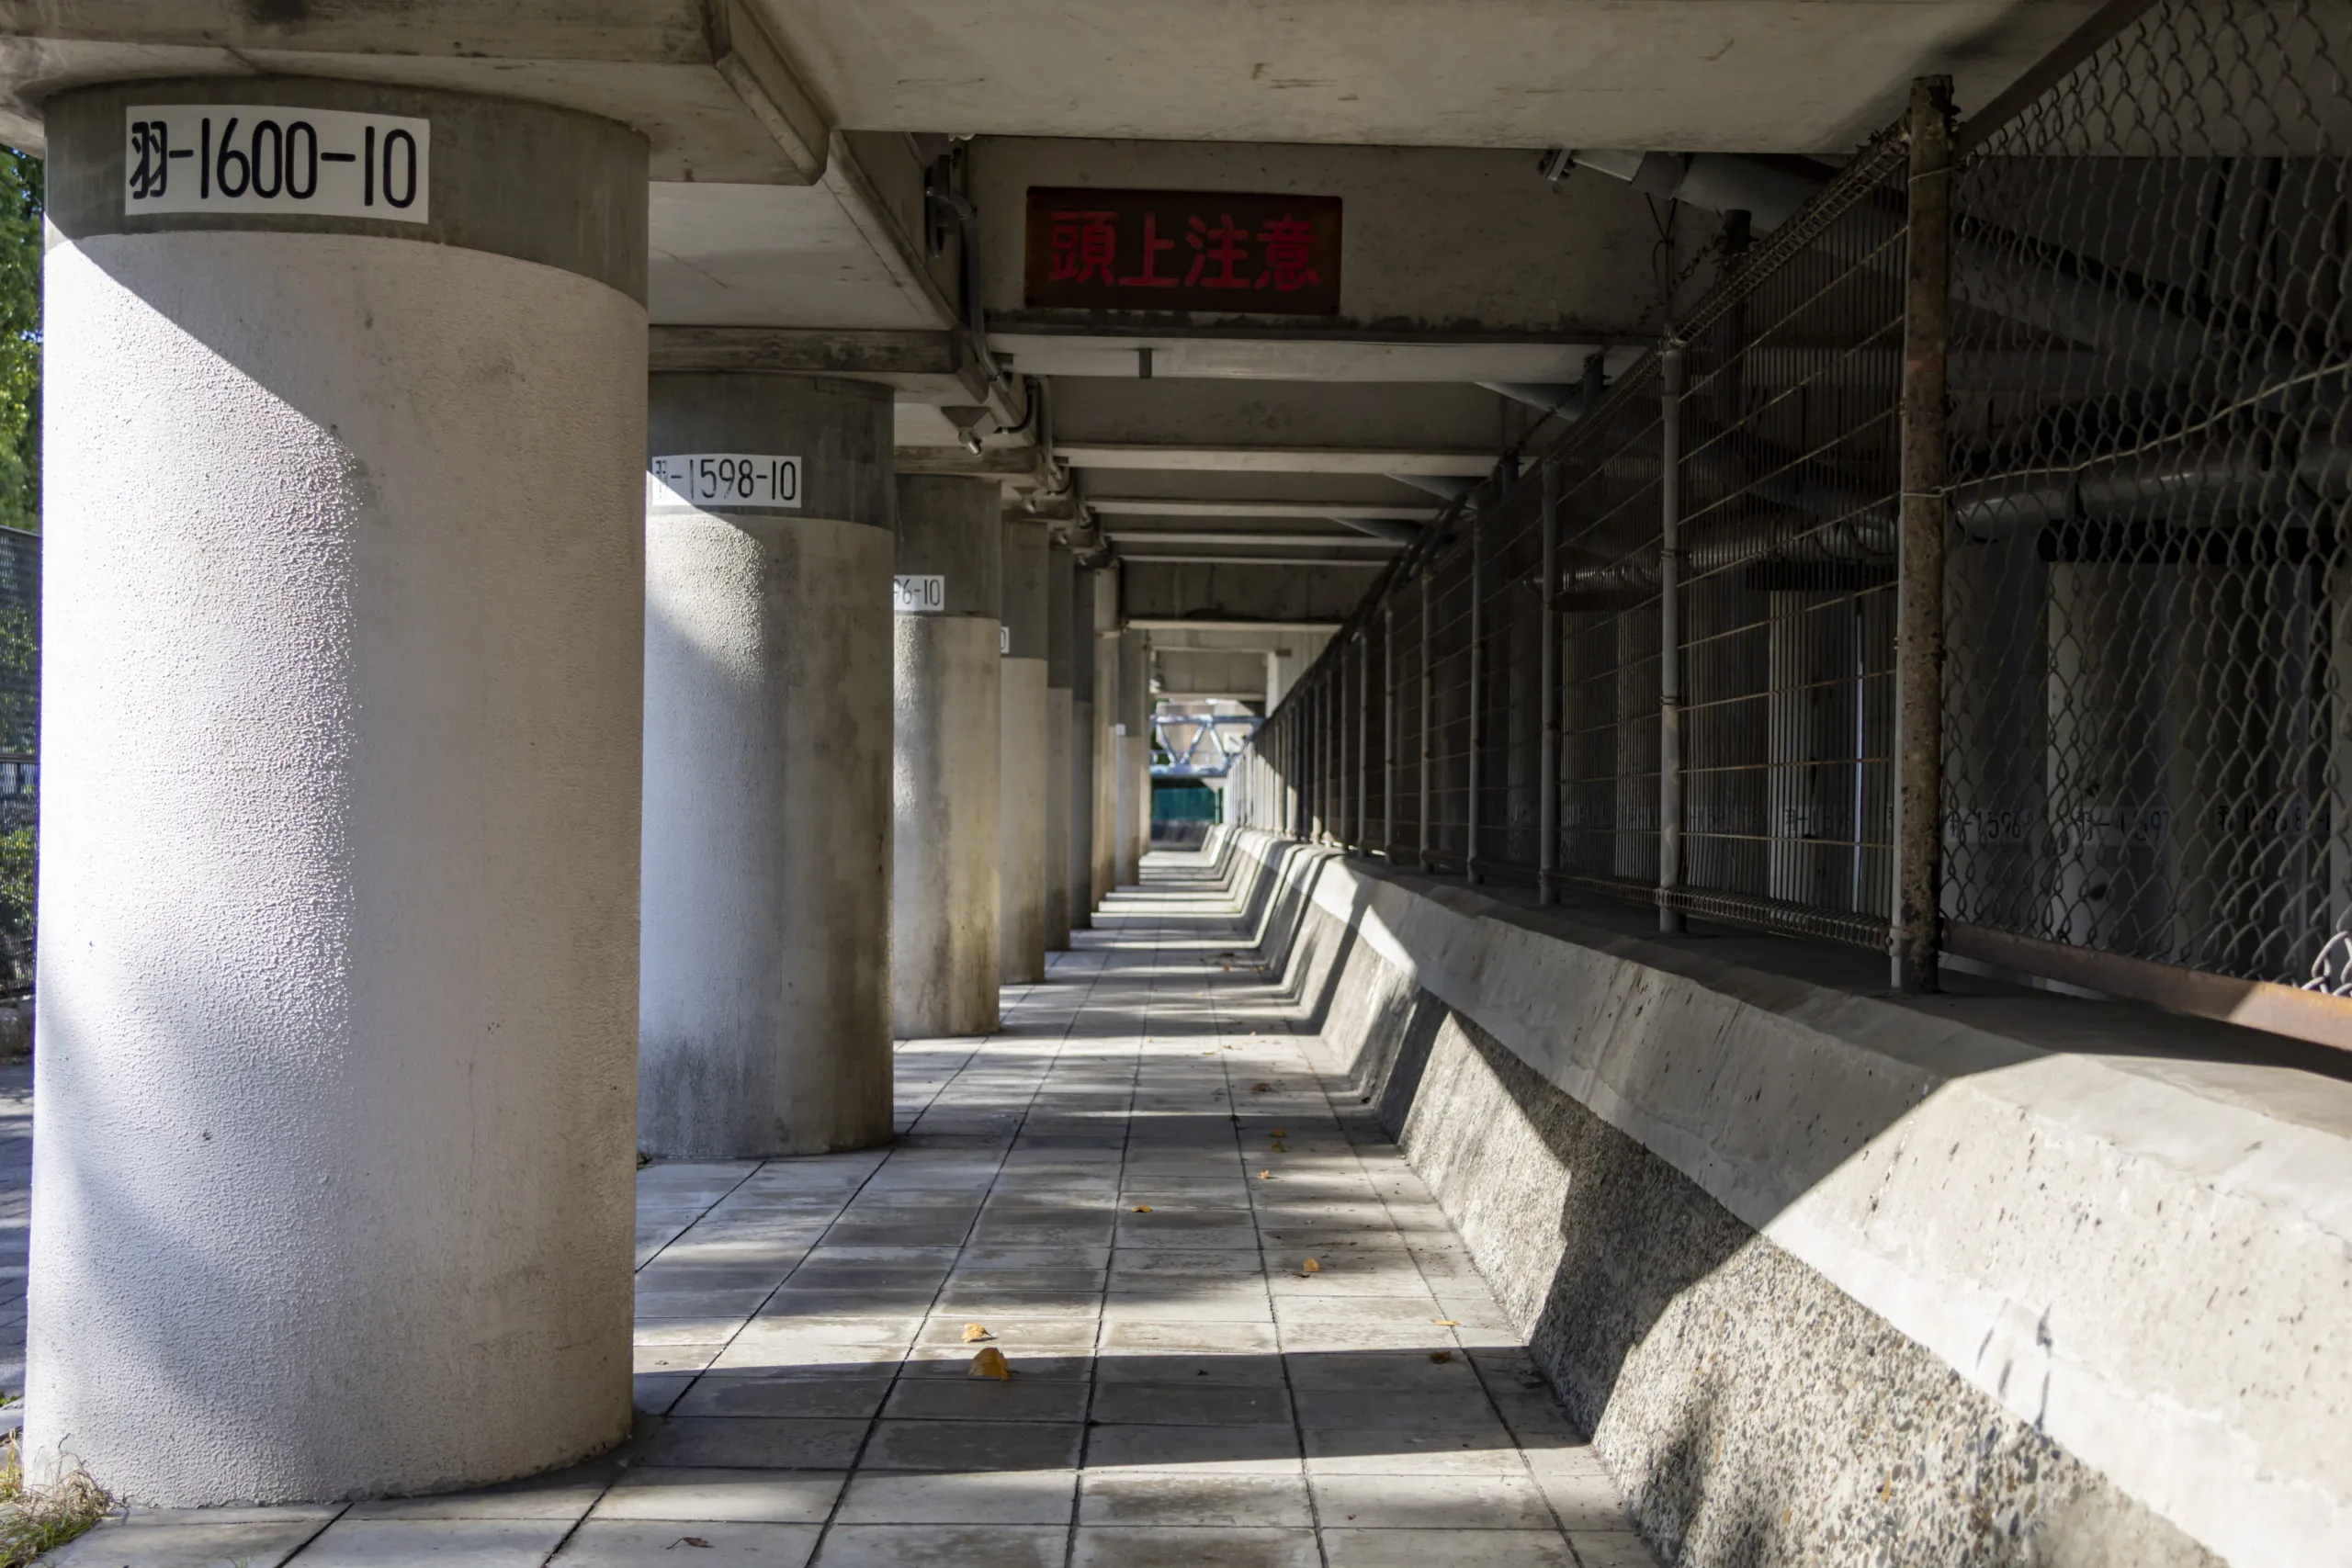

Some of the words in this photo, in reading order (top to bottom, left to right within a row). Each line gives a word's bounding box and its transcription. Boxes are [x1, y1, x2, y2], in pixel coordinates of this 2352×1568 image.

[130, 118, 417, 209] 羽-1600-10
[1048, 210, 1321, 292] 頭上注意
